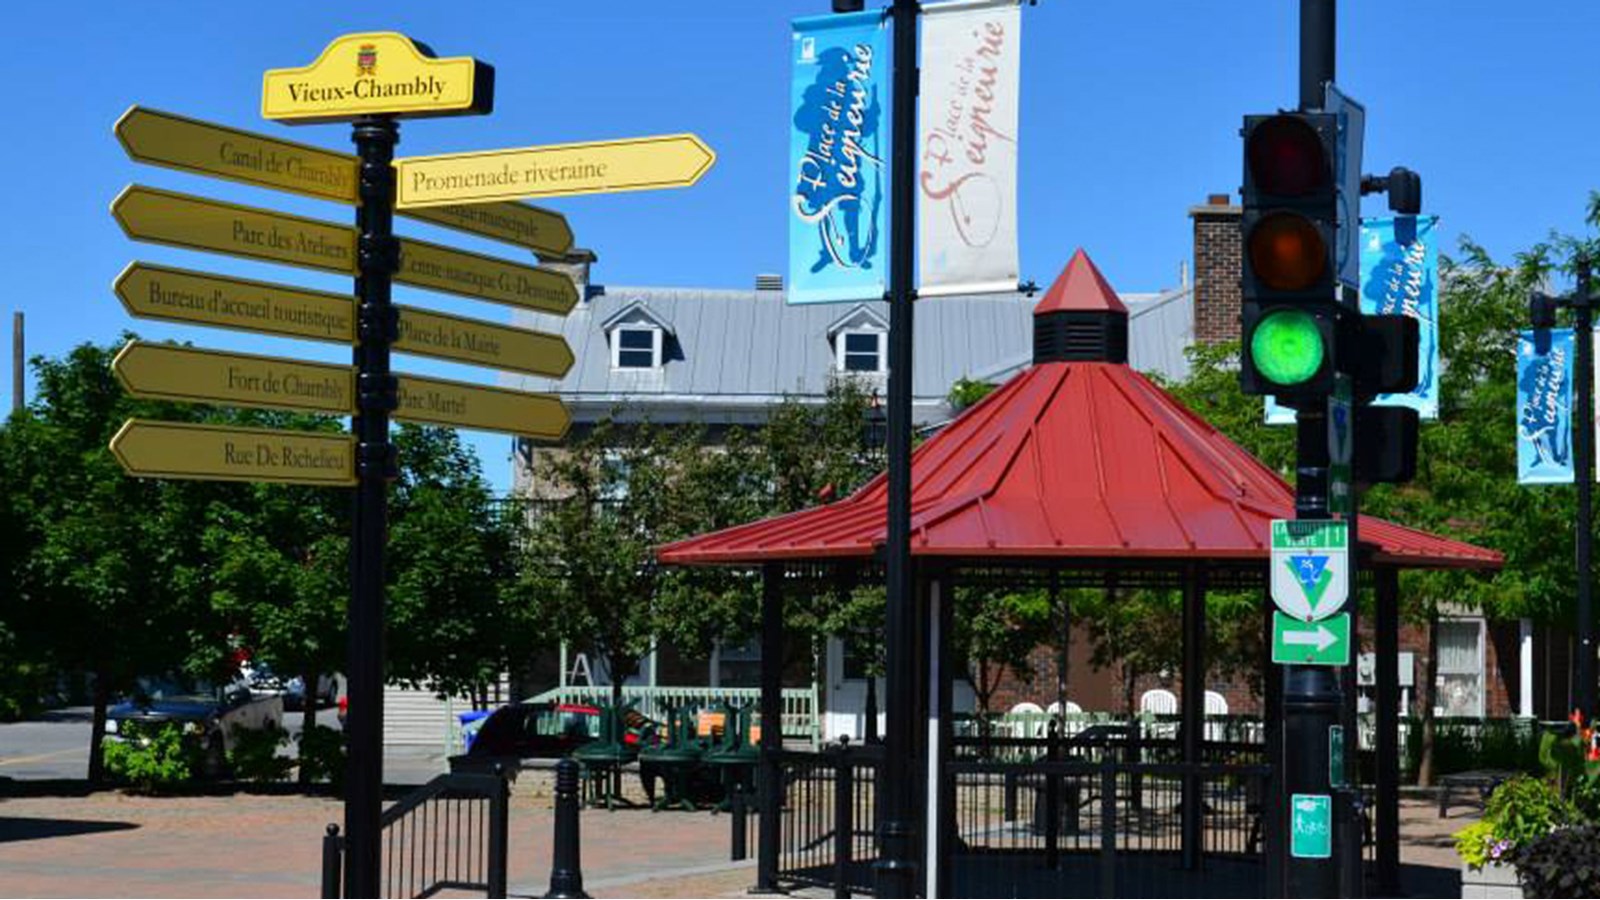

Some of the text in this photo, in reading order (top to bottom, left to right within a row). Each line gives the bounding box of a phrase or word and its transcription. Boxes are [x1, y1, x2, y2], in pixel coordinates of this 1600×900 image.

[289, 75, 446, 101] Vieux-Chambly
[798, 80, 847, 191] Place de la
[925, 100, 962, 168] Place
[219, 140, 263, 171] Canal
[265, 151, 284, 174] de
[793, 43, 885, 268] Seigneurie
[412, 160, 608, 193] Promenade riveraine
[232, 219, 265, 246] Parc
[267, 225, 292, 249] des
[150, 281, 347, 334] Bureau d'accueil touristique
[398, 319, 431, 344] Place
[433, 324, 449, 347] de
[451, 327, 461, 348] la
[228, 366, 344, 407] Fort de Chambly
[397, 387, 425, 409] Parc
[225, 443, 343, 470] Rue De Richelieu
